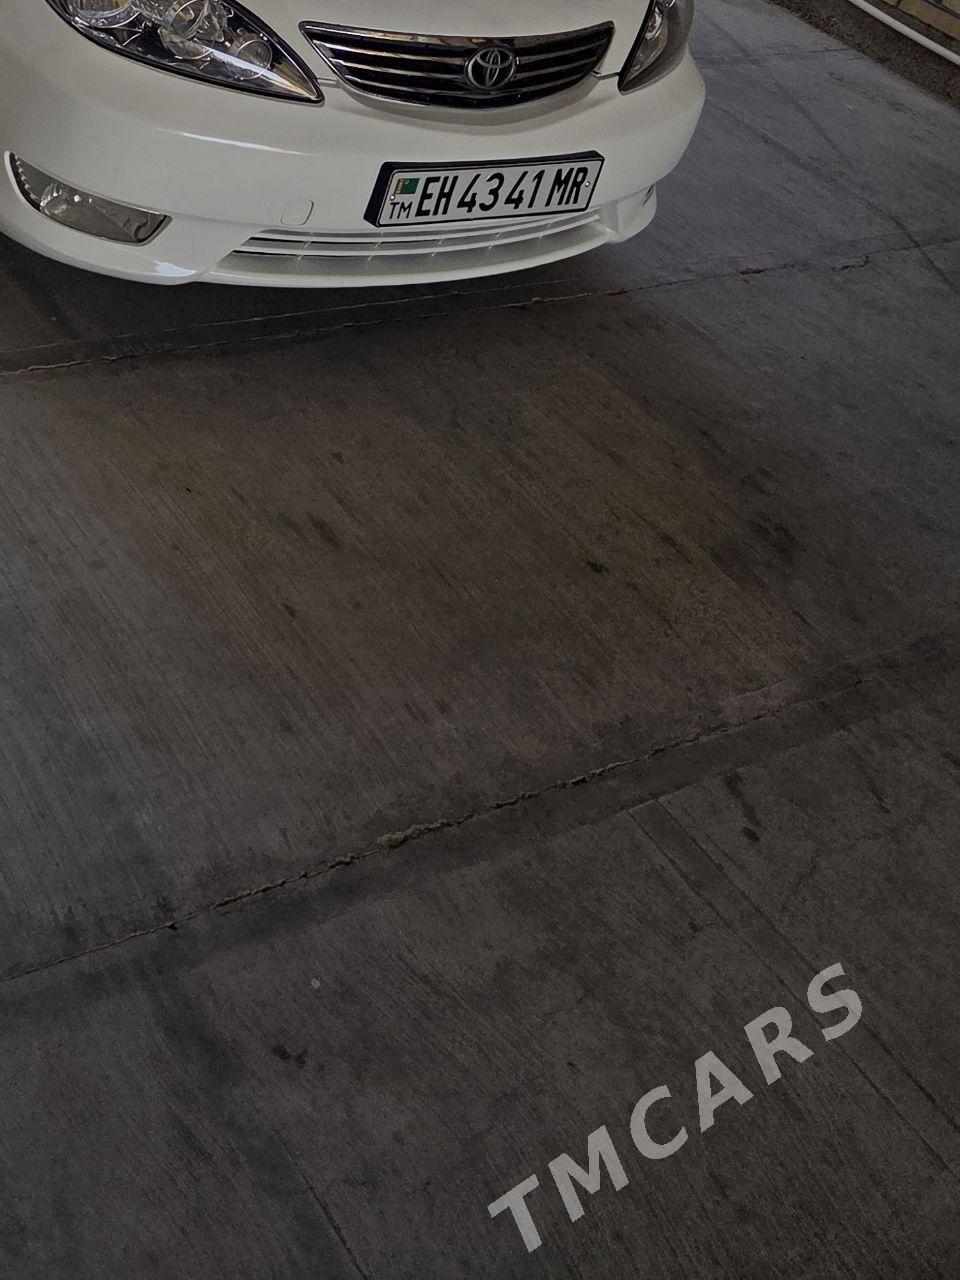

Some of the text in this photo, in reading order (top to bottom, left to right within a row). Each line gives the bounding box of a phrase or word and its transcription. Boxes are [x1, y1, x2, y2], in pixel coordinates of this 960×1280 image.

[415, 166, 589, 217] EH 4341 MR
[390, 201, 412, 219] TM
